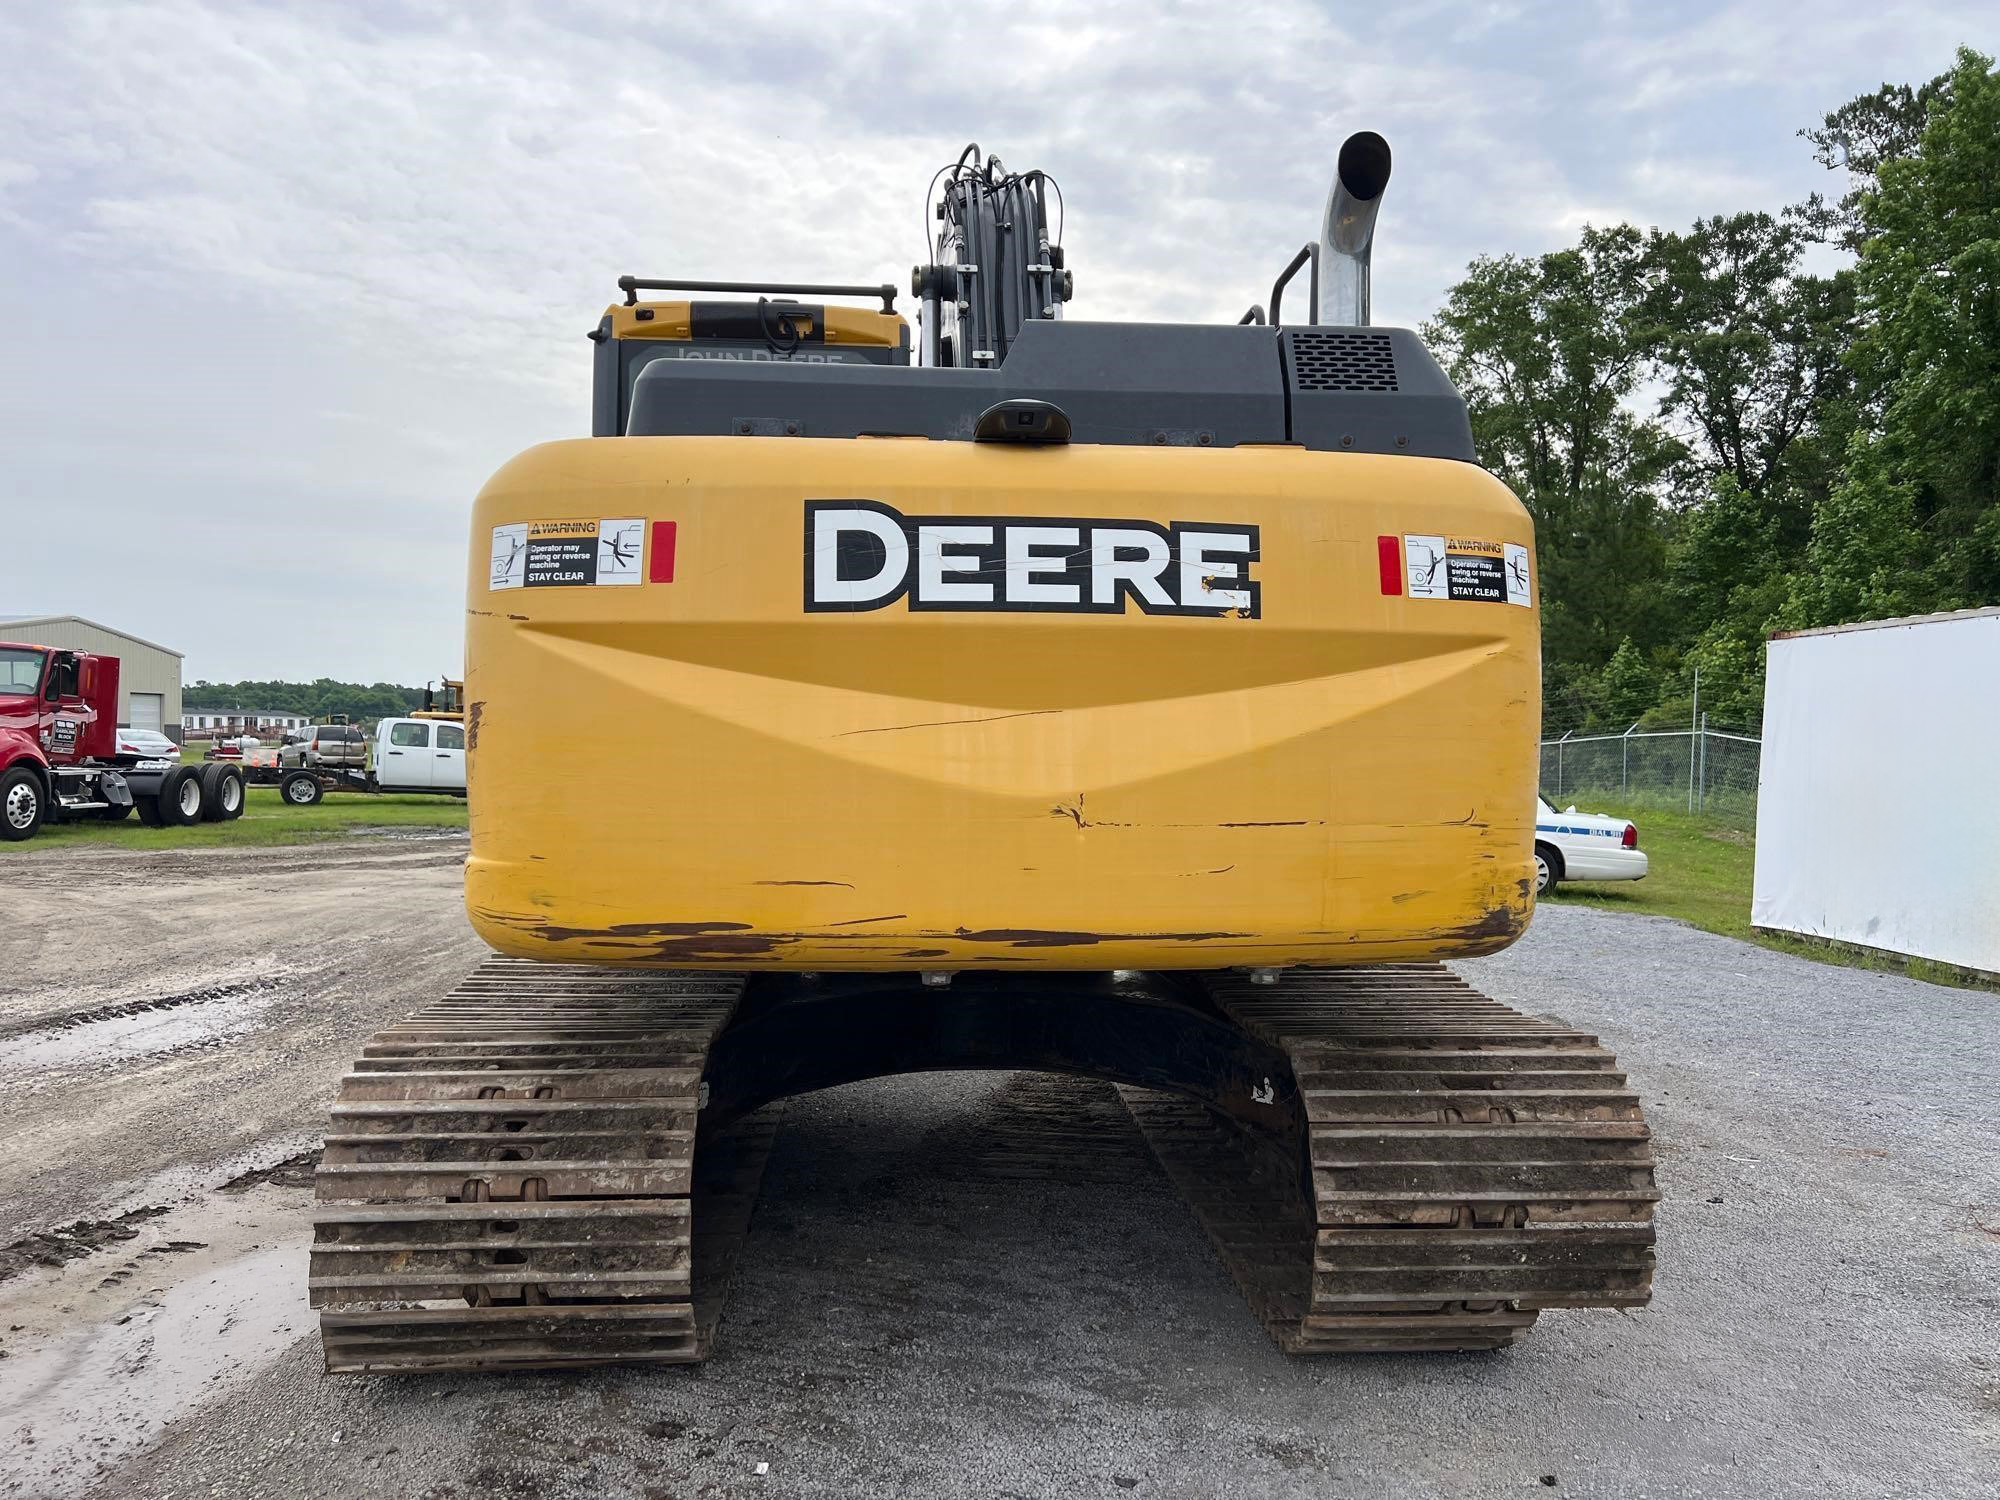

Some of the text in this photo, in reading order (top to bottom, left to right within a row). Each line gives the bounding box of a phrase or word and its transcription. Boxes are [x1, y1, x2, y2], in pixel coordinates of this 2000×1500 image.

[542, 522, 596, 534] WARNING
[531, 544, 580, 554] Operator may
[1458, 539, 1502, 553] WARNING
[530, 552, 551, 562] swing
[562, 552, 591, 560] reverse
[812, 508, 1252, 610] DEERE
[529, 560, 560, 569] machine
[1451, 559, 1493, 570] Operator may
[528, 571, 584, 581] STAY CLEAR
[1451, 568, 1471, 577] swing
[1480, 570, 1502, 578] reverse
[1452, 576, 1479, 584] machine
[1452, 586, 1500, 598] STAY CLEAR
